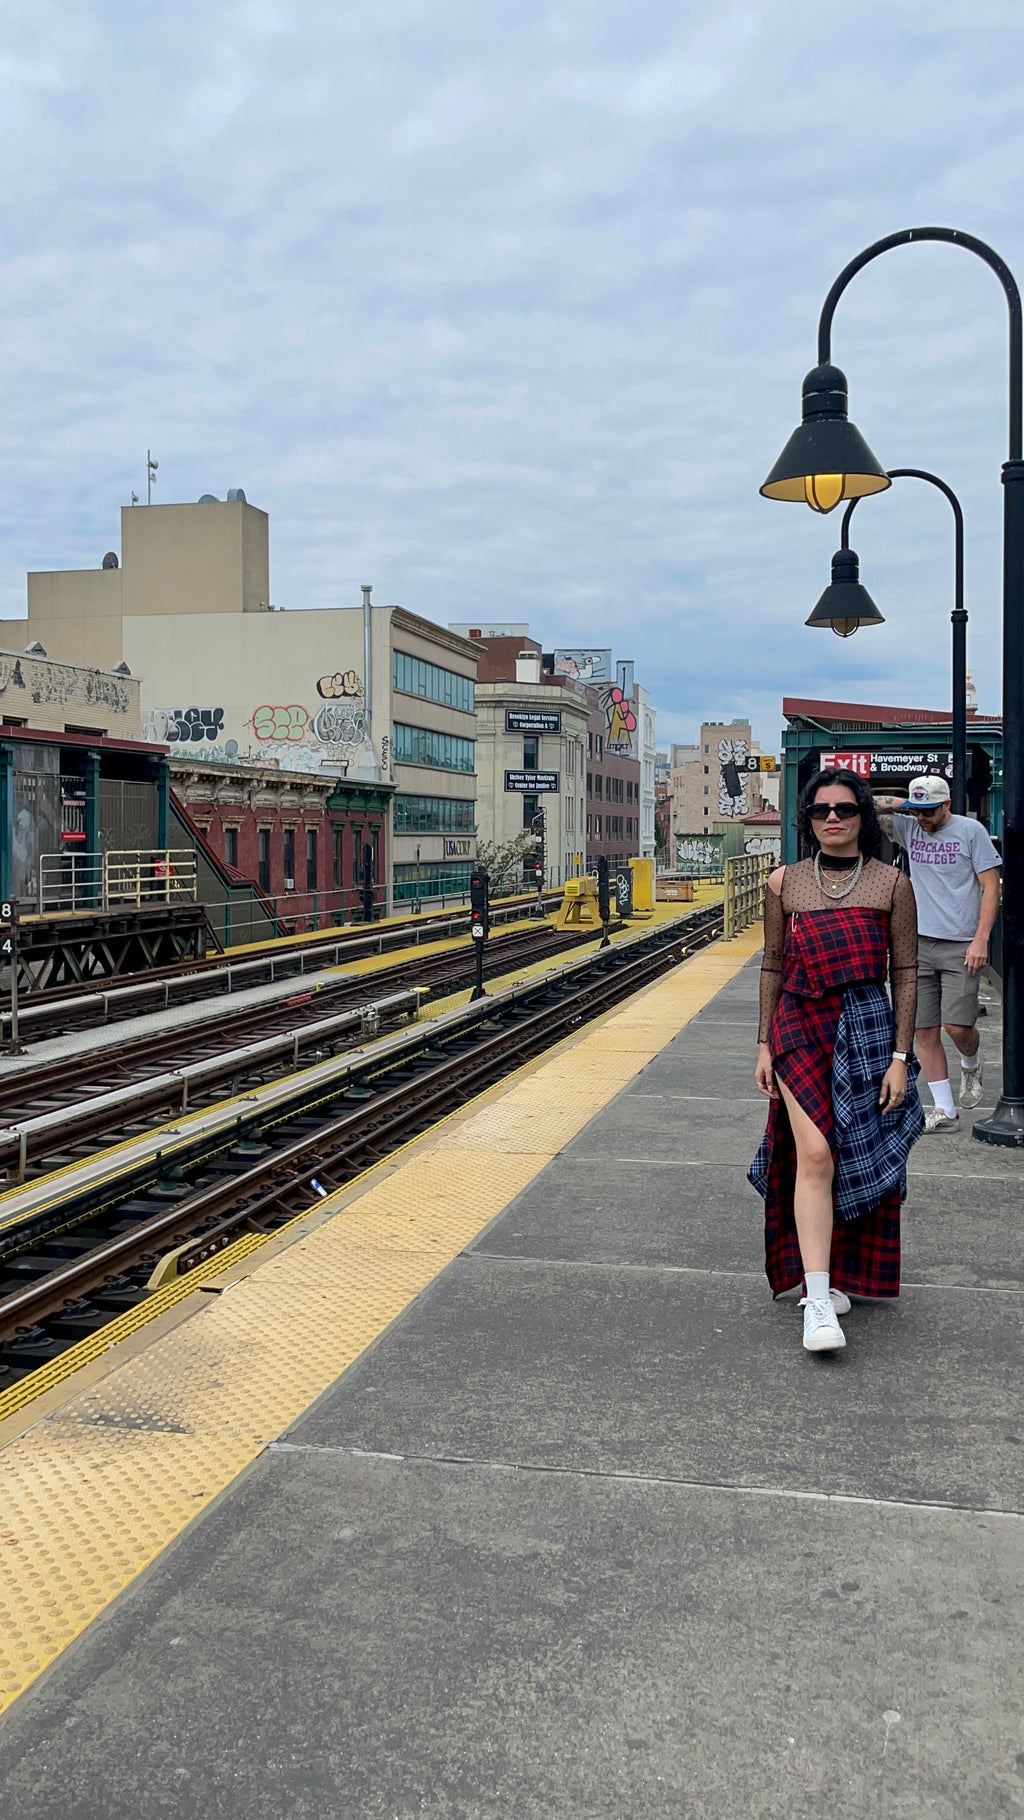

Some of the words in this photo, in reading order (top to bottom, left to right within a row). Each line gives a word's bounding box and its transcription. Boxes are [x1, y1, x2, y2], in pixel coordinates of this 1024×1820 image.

[747, 757, 757, 770] 8
[765, 762, 771, 770] S
[820, 754, 867, 775] Exit
[870, 754, 923, 763] Havemeyer
[926, 753, 938, 763] St
[870, 763, 877, 772] &
[880, 763, 928, 773] Broadway
[910, 838, 960, 853] PURCHASE
[910, 851, 957, 865] COLLEGE
[1, 903, 12, 918] 8
[2, 938, 13, 954] 4
